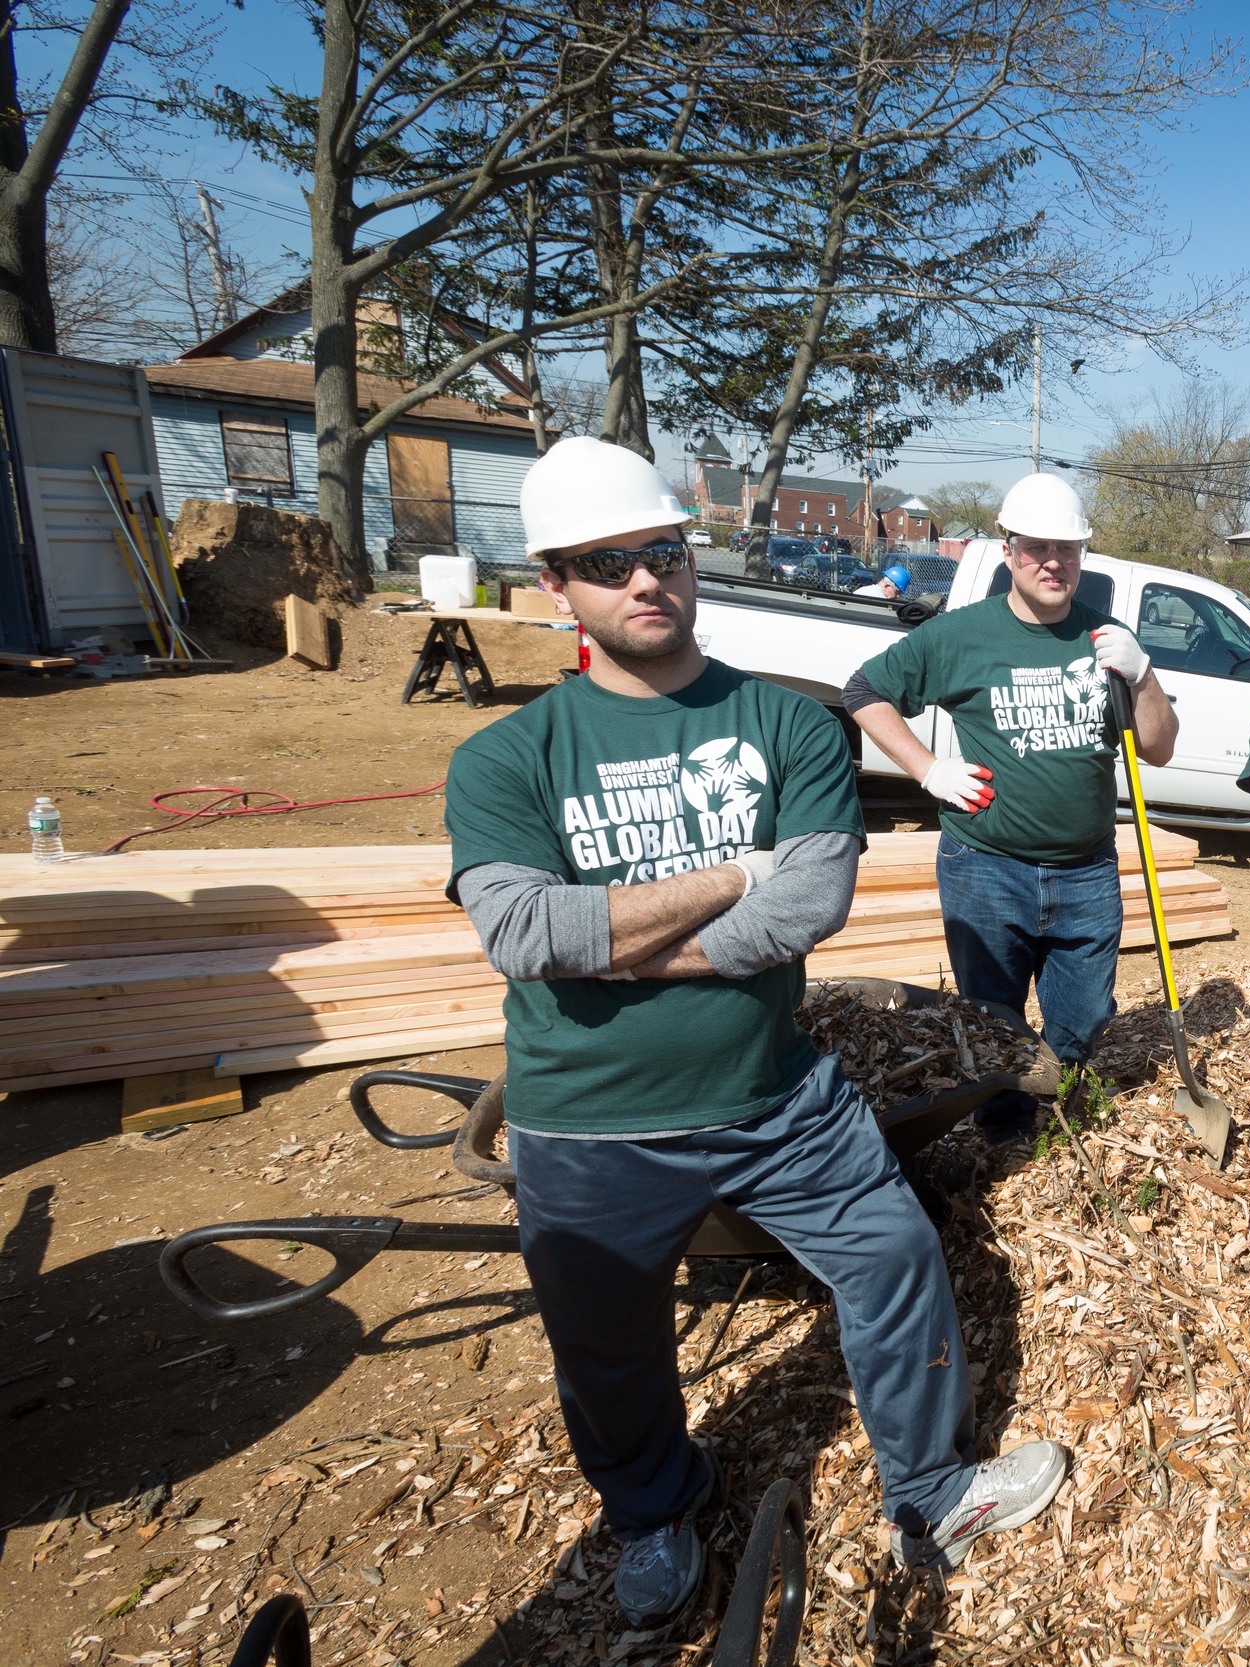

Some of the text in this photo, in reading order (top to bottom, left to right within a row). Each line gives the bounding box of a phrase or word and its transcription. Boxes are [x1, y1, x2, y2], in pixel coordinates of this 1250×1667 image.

[1010, 666, 1062, 676] BINGHAMTON
[1012, 675, 1062, 685] UNIVERSITY
[990, 684, 1065, 709] ALUMNI
[993, 700, 1107, 731] GLOBAL DAY
[1010, 722, 1105, 758] of SERVICE
[563, 782, 685, 834] ALUMNI
[571, 808, 758, 871] GLOBAL DAY
